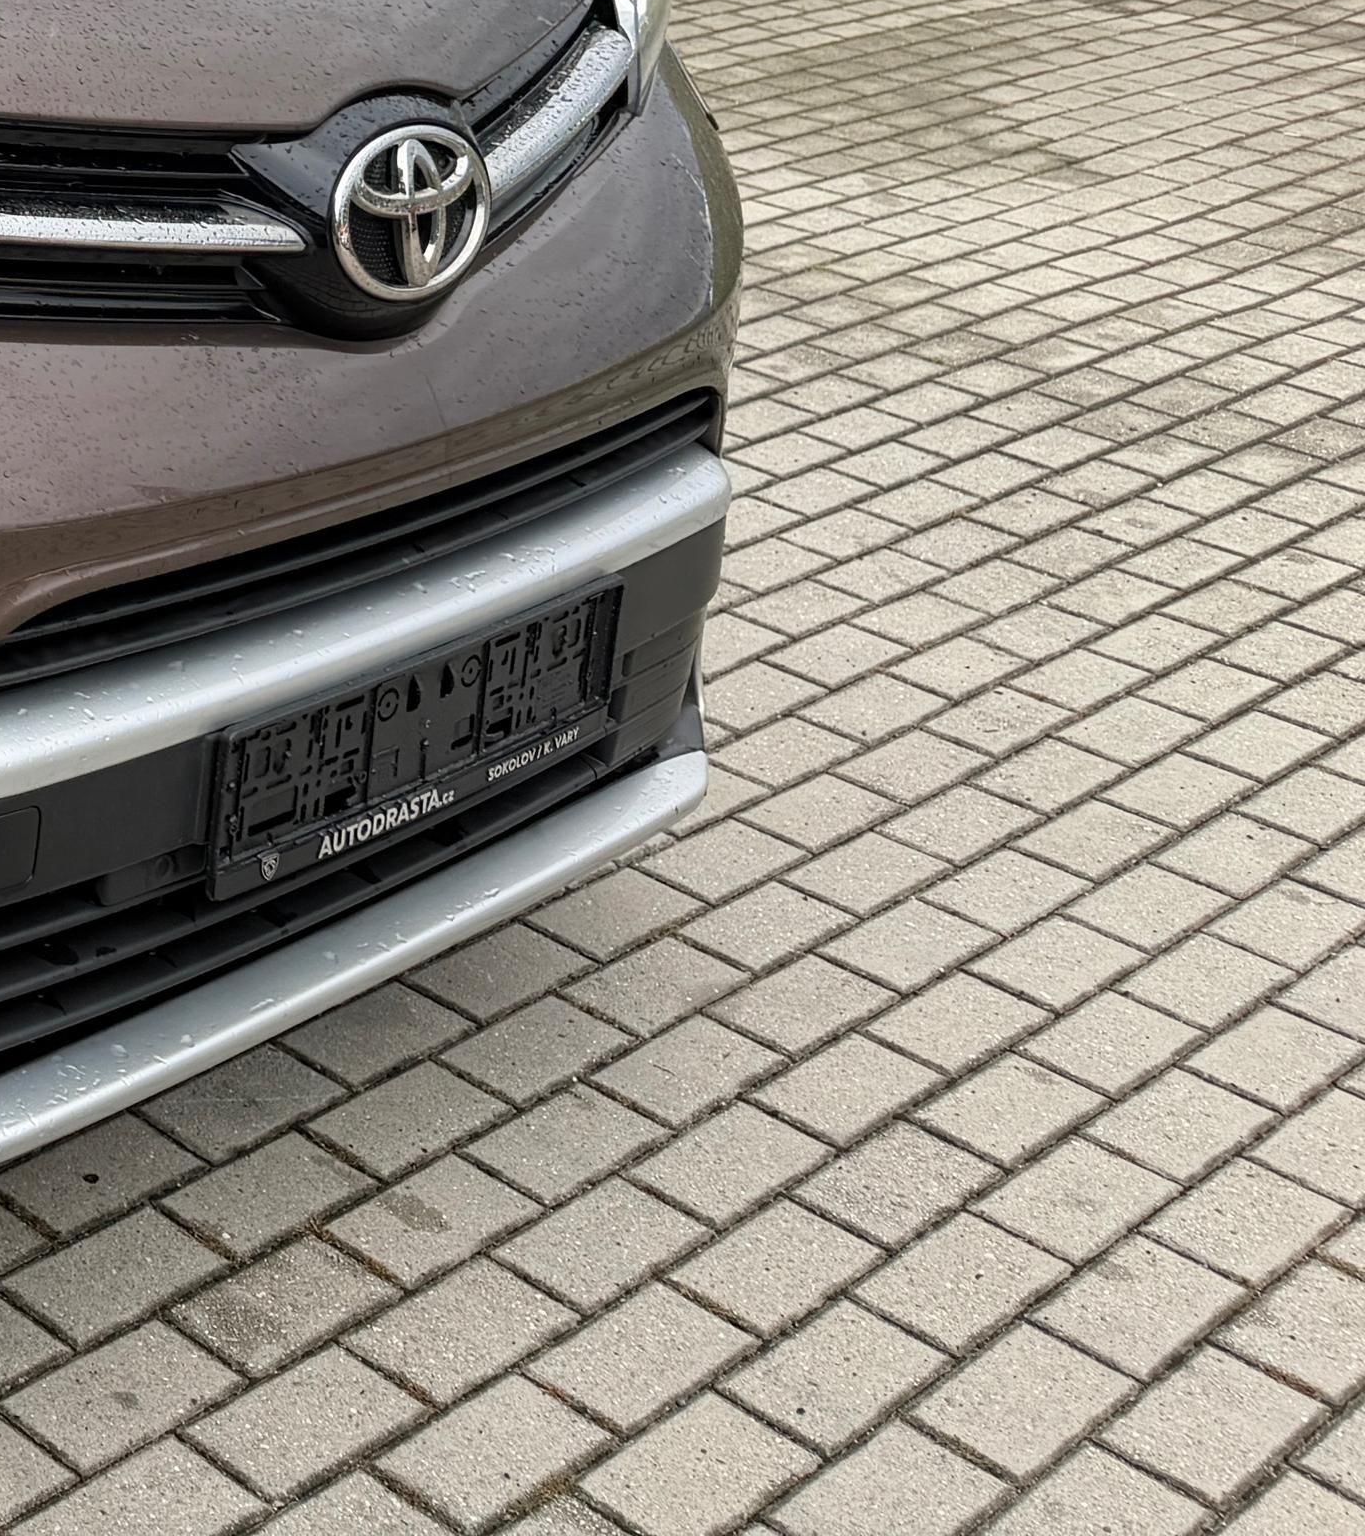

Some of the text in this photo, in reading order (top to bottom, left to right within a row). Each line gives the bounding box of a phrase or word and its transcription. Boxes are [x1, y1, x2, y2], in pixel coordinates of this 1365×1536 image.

[488, 748, 536, 782] SOKOLOV
[543, 740, 555, 757] K.
[555, 726, 580, 752] VARY
[319, 788, 455, 860] AUTODRASTA.cz
